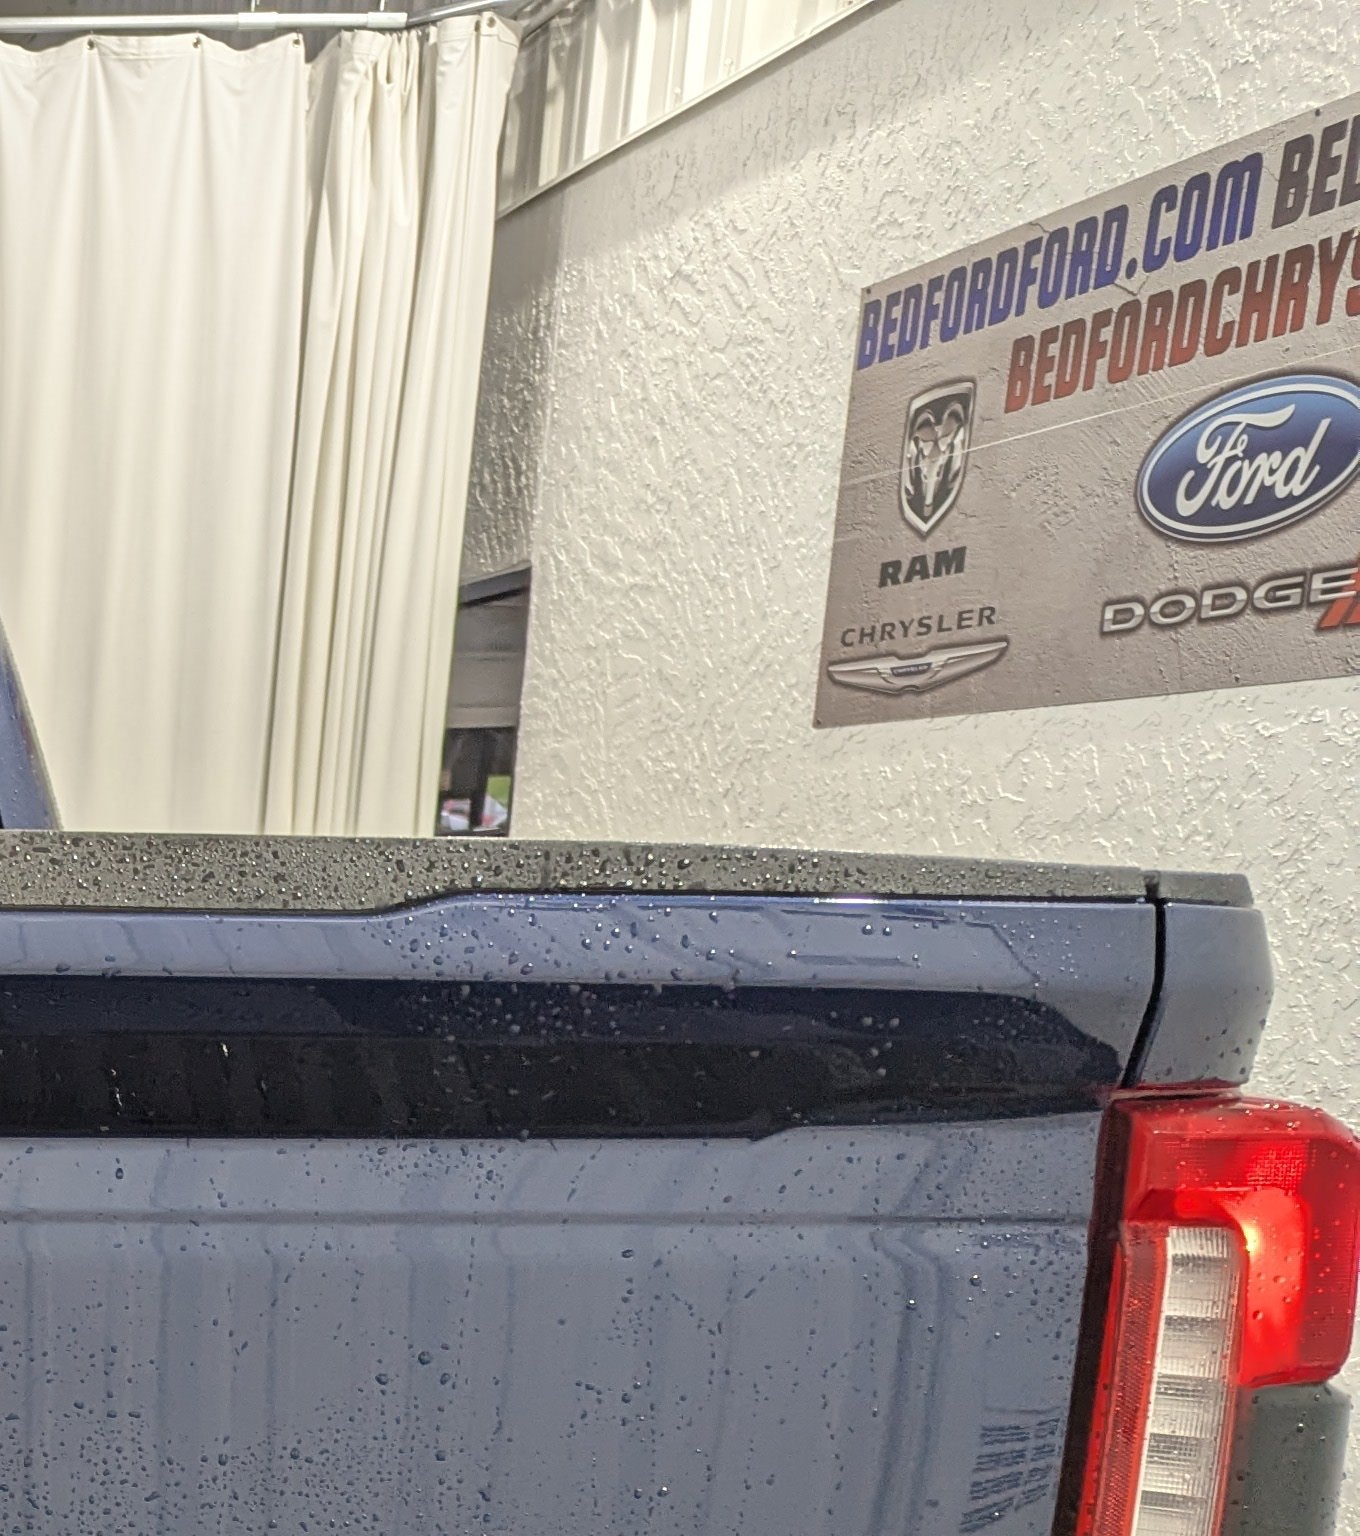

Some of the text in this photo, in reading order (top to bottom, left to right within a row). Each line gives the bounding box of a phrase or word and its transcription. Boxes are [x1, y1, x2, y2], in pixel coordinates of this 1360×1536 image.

[856, 152, 1264, 370] BEDFORDFORD.COM
[1176, 402, 1332, 519] Ford
[878, 545, 967, 589] RAM
[1100, 567, 1359, 633] DODGE
[840, 606, 997, 647] CHRYSLER
